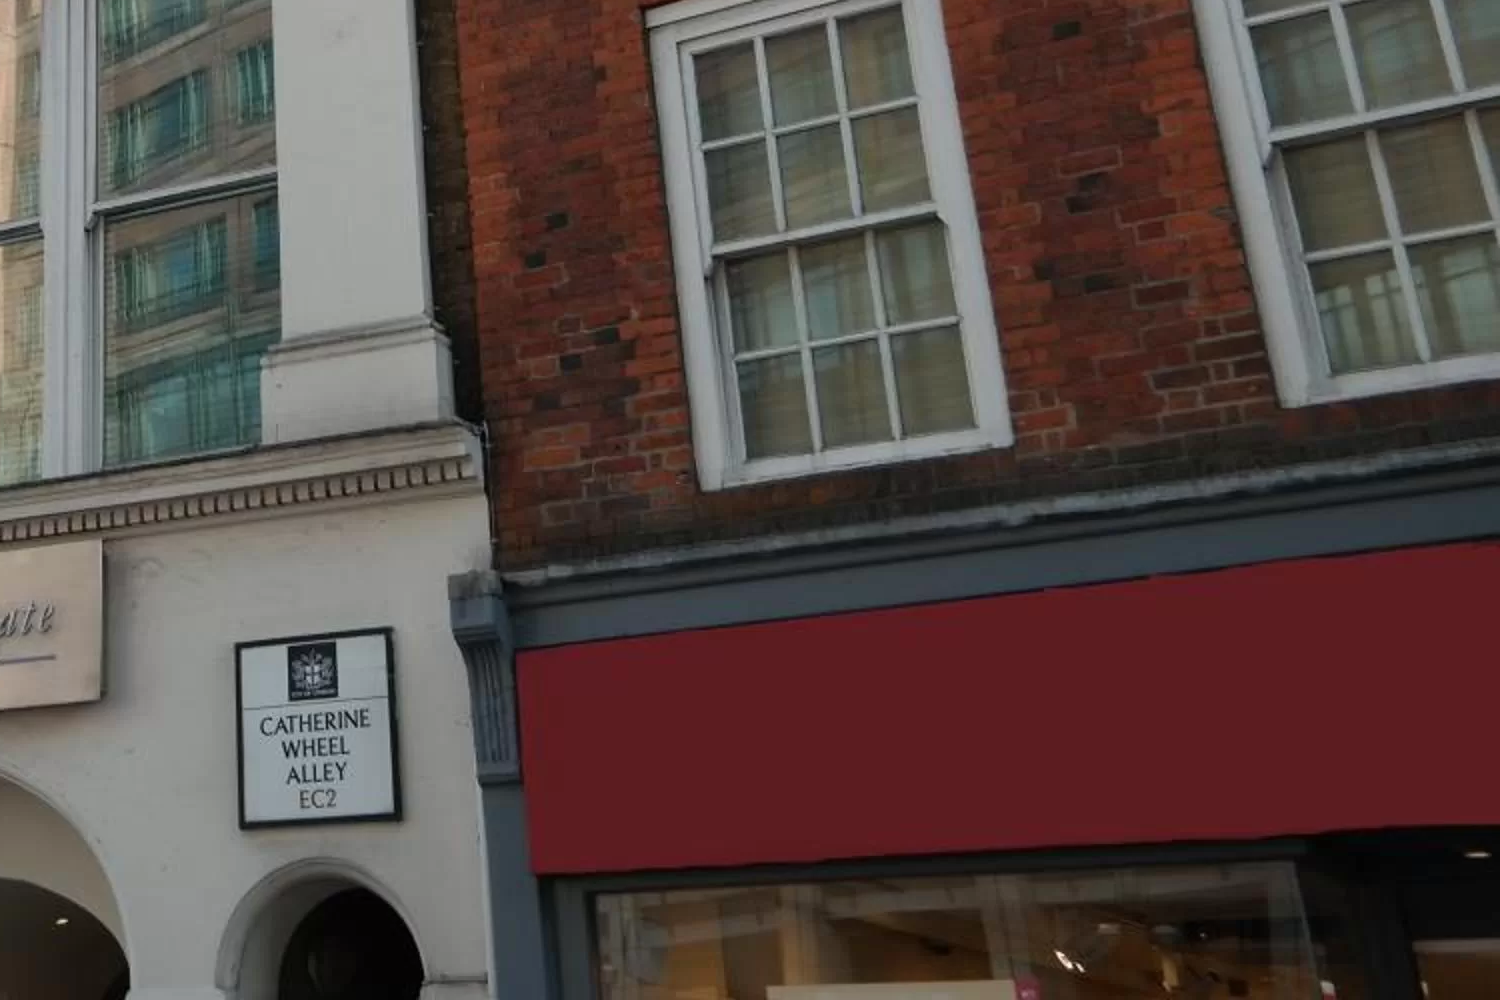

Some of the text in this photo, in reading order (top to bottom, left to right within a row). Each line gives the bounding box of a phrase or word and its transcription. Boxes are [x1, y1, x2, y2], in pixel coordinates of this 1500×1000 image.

[260, 708, 370, 736] CATHERINE
[281, 736, 350, 759] WHEEL
[285, 761, 347, 785] ALLEY
[299, 788, 337, 809] EC2
